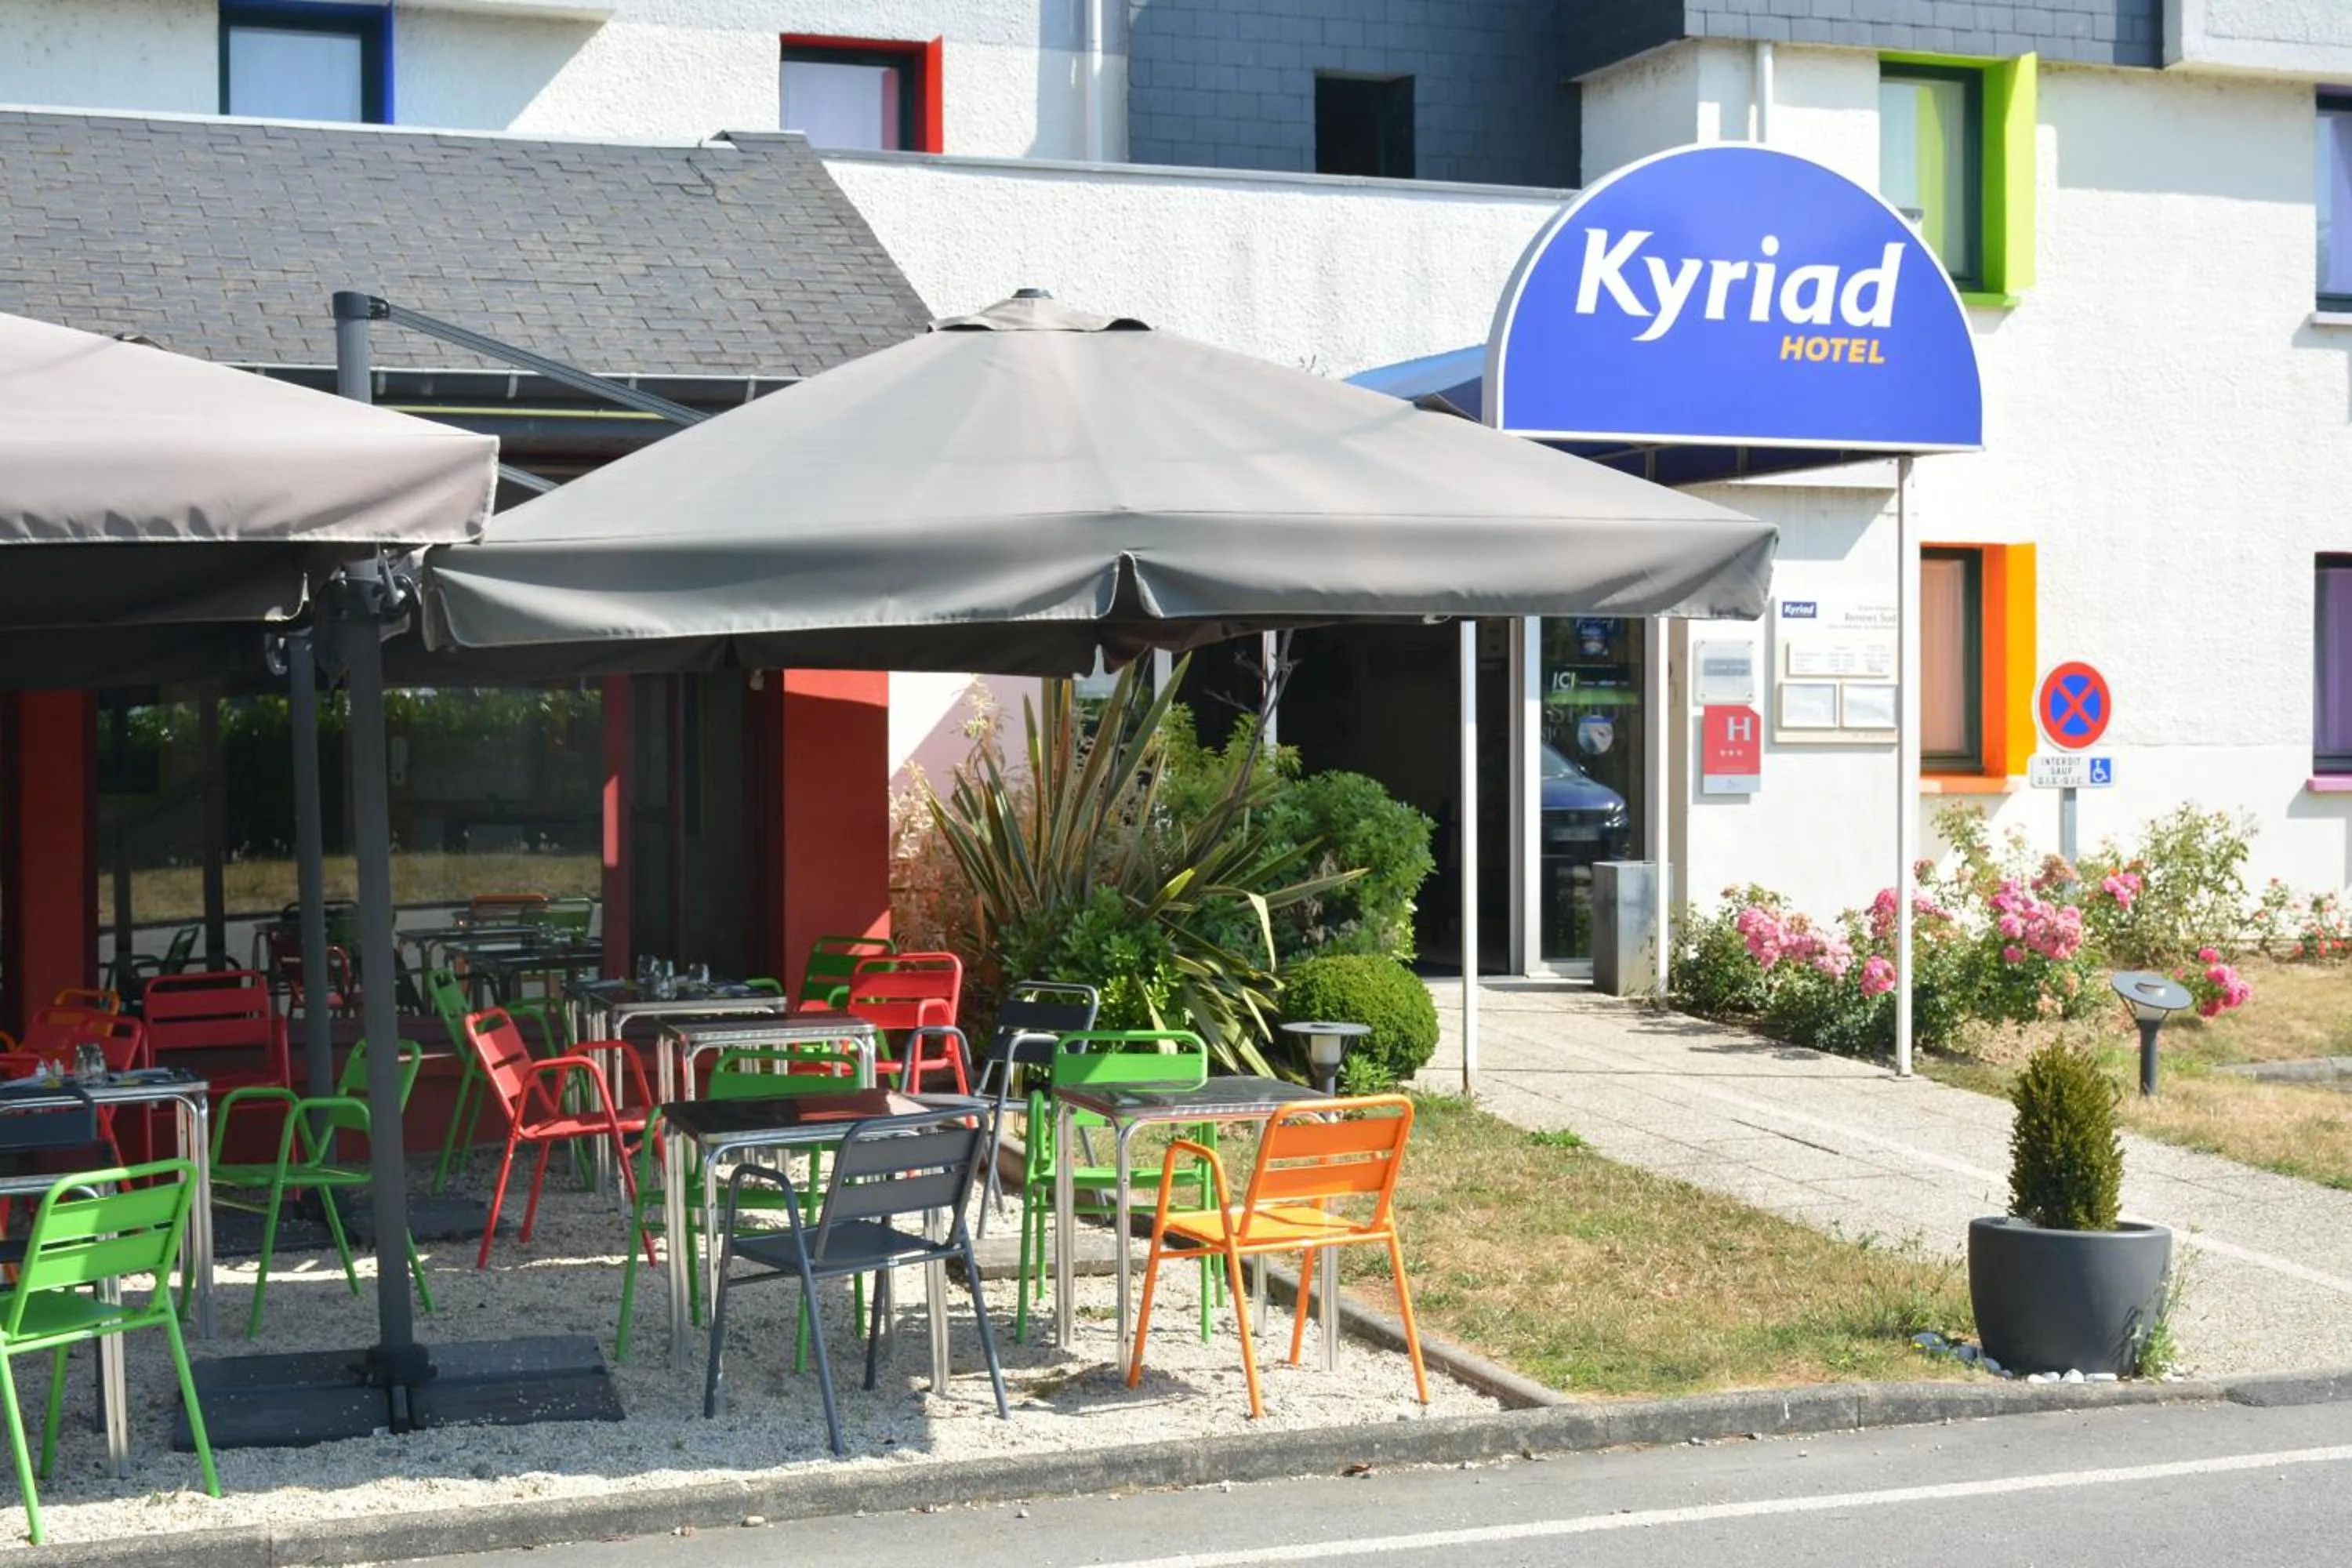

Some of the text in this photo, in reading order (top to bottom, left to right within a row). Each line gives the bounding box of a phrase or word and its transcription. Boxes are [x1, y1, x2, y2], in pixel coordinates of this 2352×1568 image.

[1575, 227, 1907, 342] Kyriad
[1780, 335, 1886, 365] HOTEL
[1784, 603, 1815, 615] Kyriad
[1727, 716, 1752, 742] H
[2040, 757, 2082, 766] INTERDIT
[2050, 766, 2073, 775] SAUF
